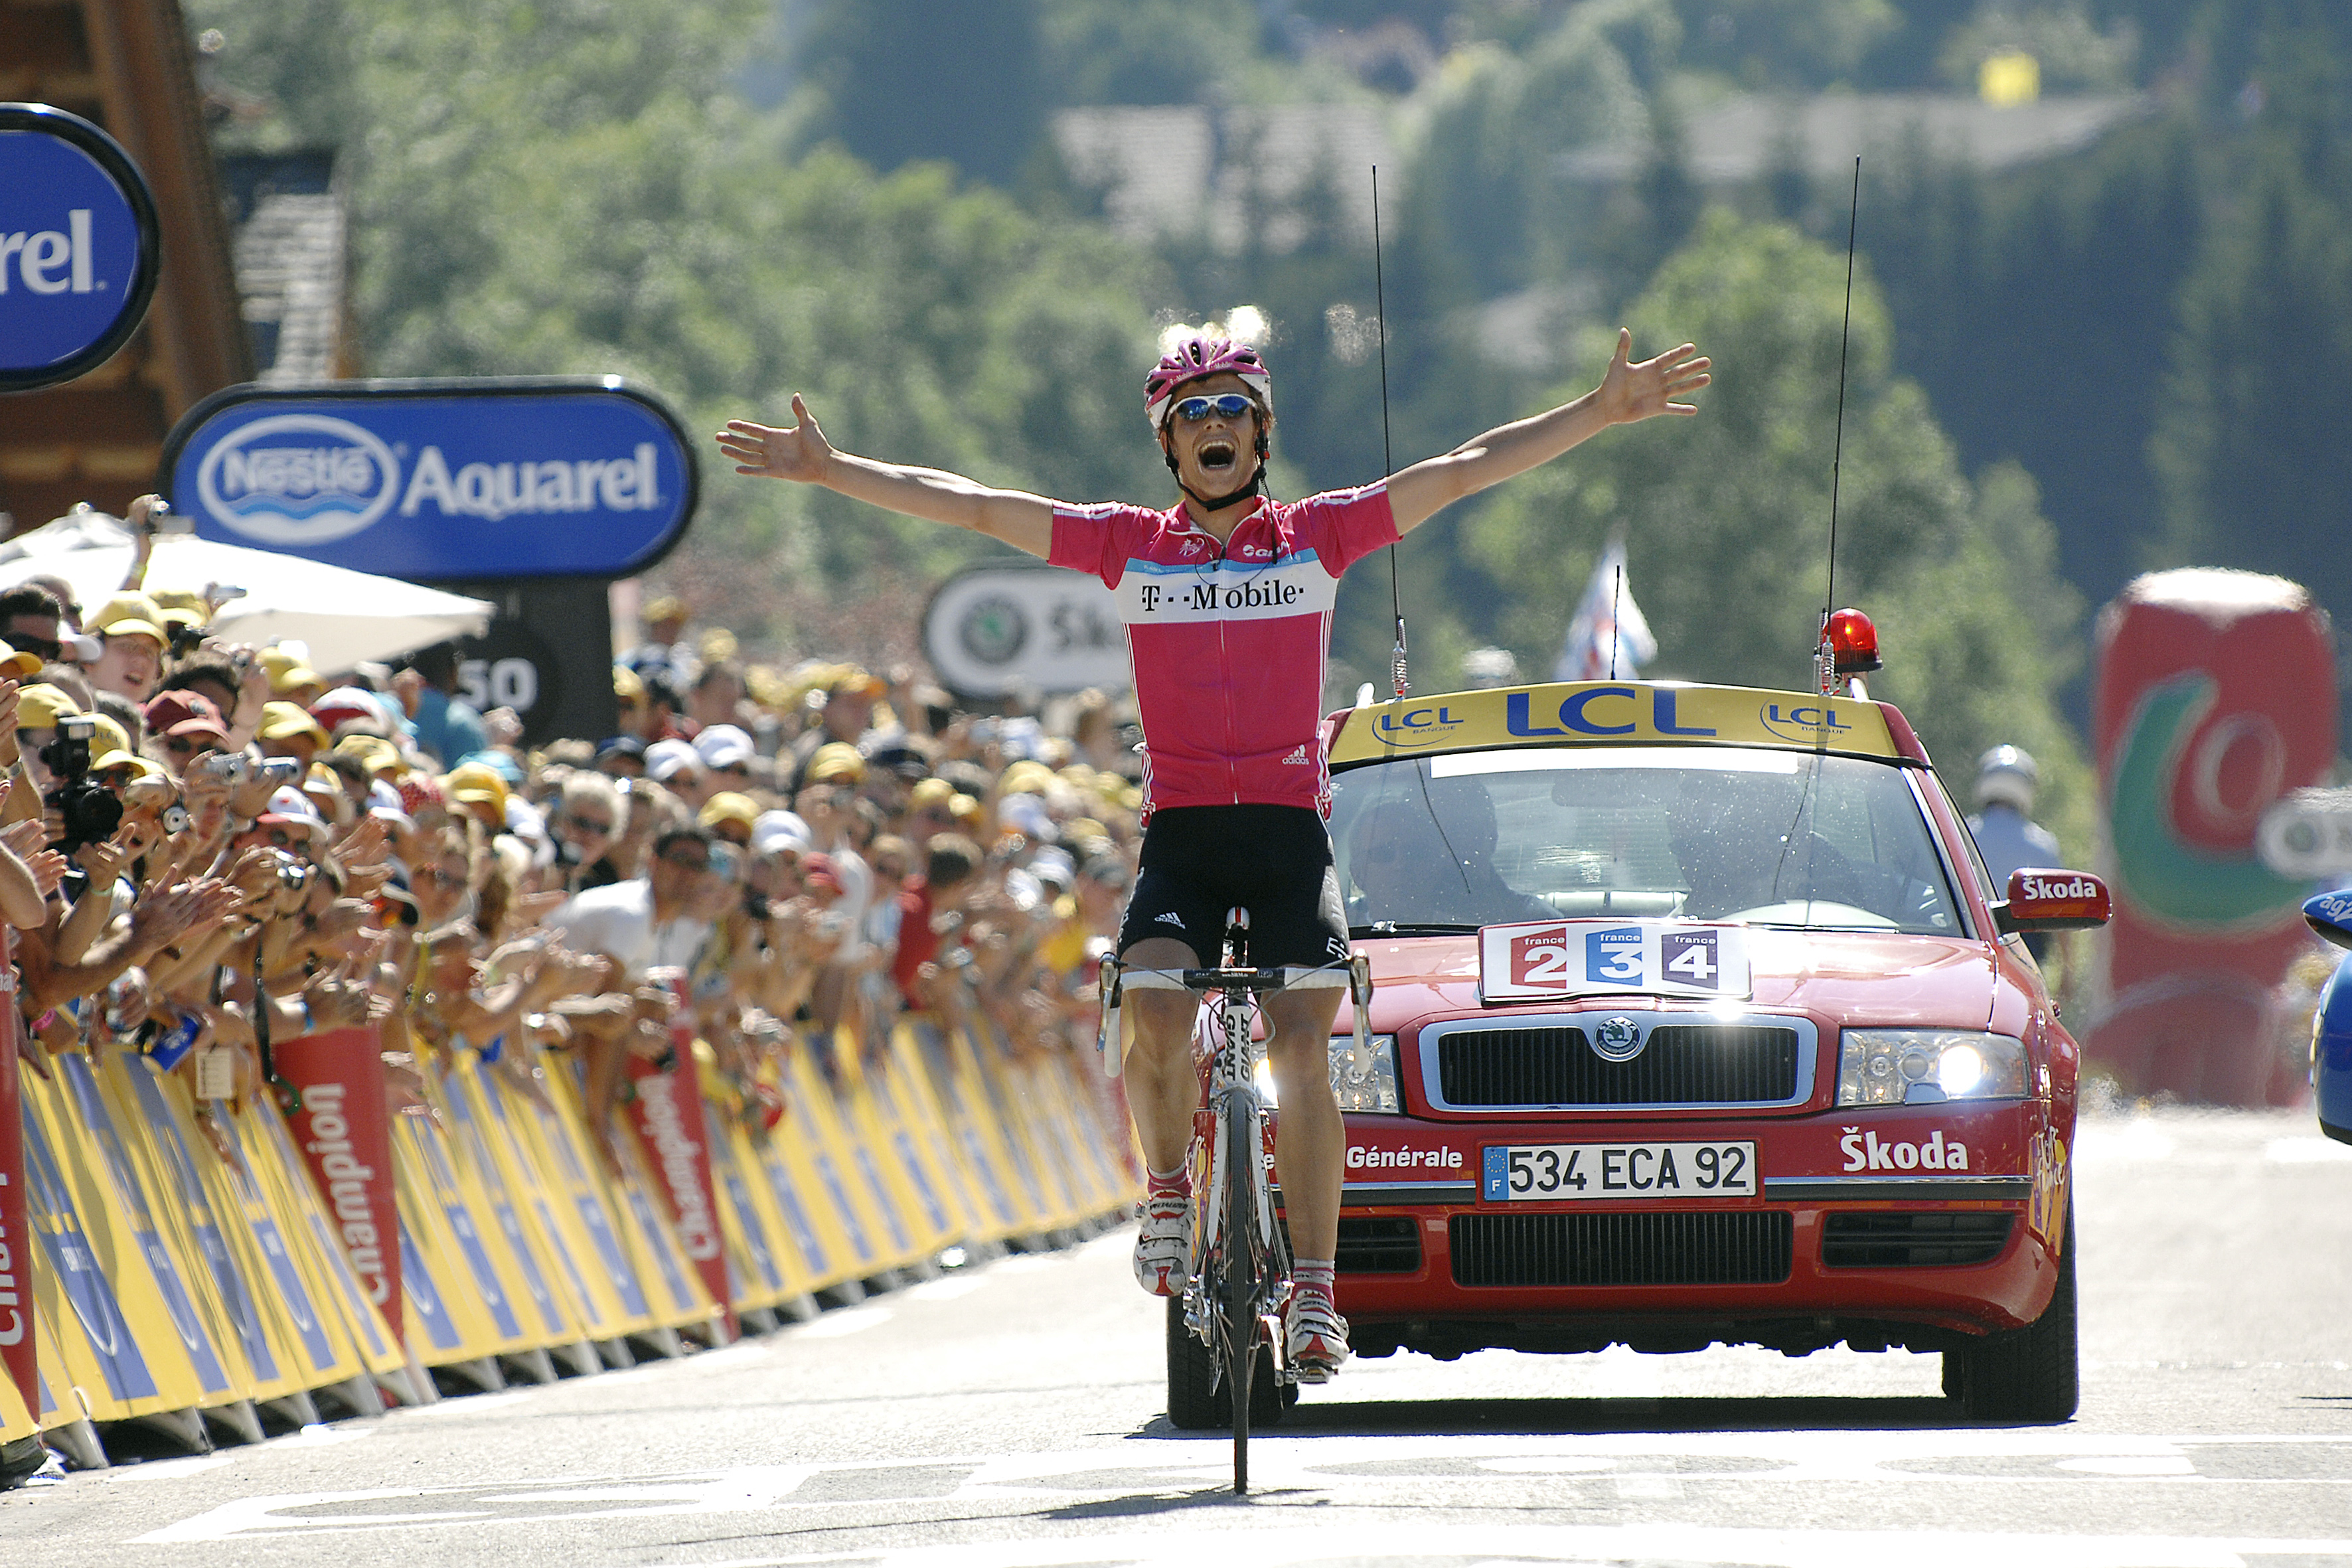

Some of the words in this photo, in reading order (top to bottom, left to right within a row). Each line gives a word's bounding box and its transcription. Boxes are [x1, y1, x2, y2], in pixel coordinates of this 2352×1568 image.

[400, 443, 659, 520] Aquarel
[452, 657, 538, 713] 50
[1381, 707, 1464, 731] LCL
[1507, 687, 1717, 736] LCL
[1769, 704, 1852, 730] LCL
[1413, 725, 1456, 734] BANQUE
[1801, 726, 1845, 734] BANQUE
[1282, 755, 1310, 765] adidas
[2023, 876, 2097, 900] Škoda
[1154, 915, 1186, 929] adidas
[1524, 936, 1566, 945] france
[1600, 933, 1641, 942] france
[1675, 935, 1717, 945] france
[1524, 946, 1567, 982] 2
[1599, 943, 1642, 979] 3
[1668, 945, 1717, 979] 4
[1224, 1014, 1235, 1081] GIANT
[1240, 1013, 1249, 1082] GIANT
[1346, 1145, 1463, 1168] Générale
[1840, 1127, 1969, 1172] Škoda
[1509, 1150, 1587, 1193] 534
[1602, 1148, 1680, 1190] ECA
[1695, 1147, 1747, 1189] 92
[1492, 1180, 1501, 1192] F
